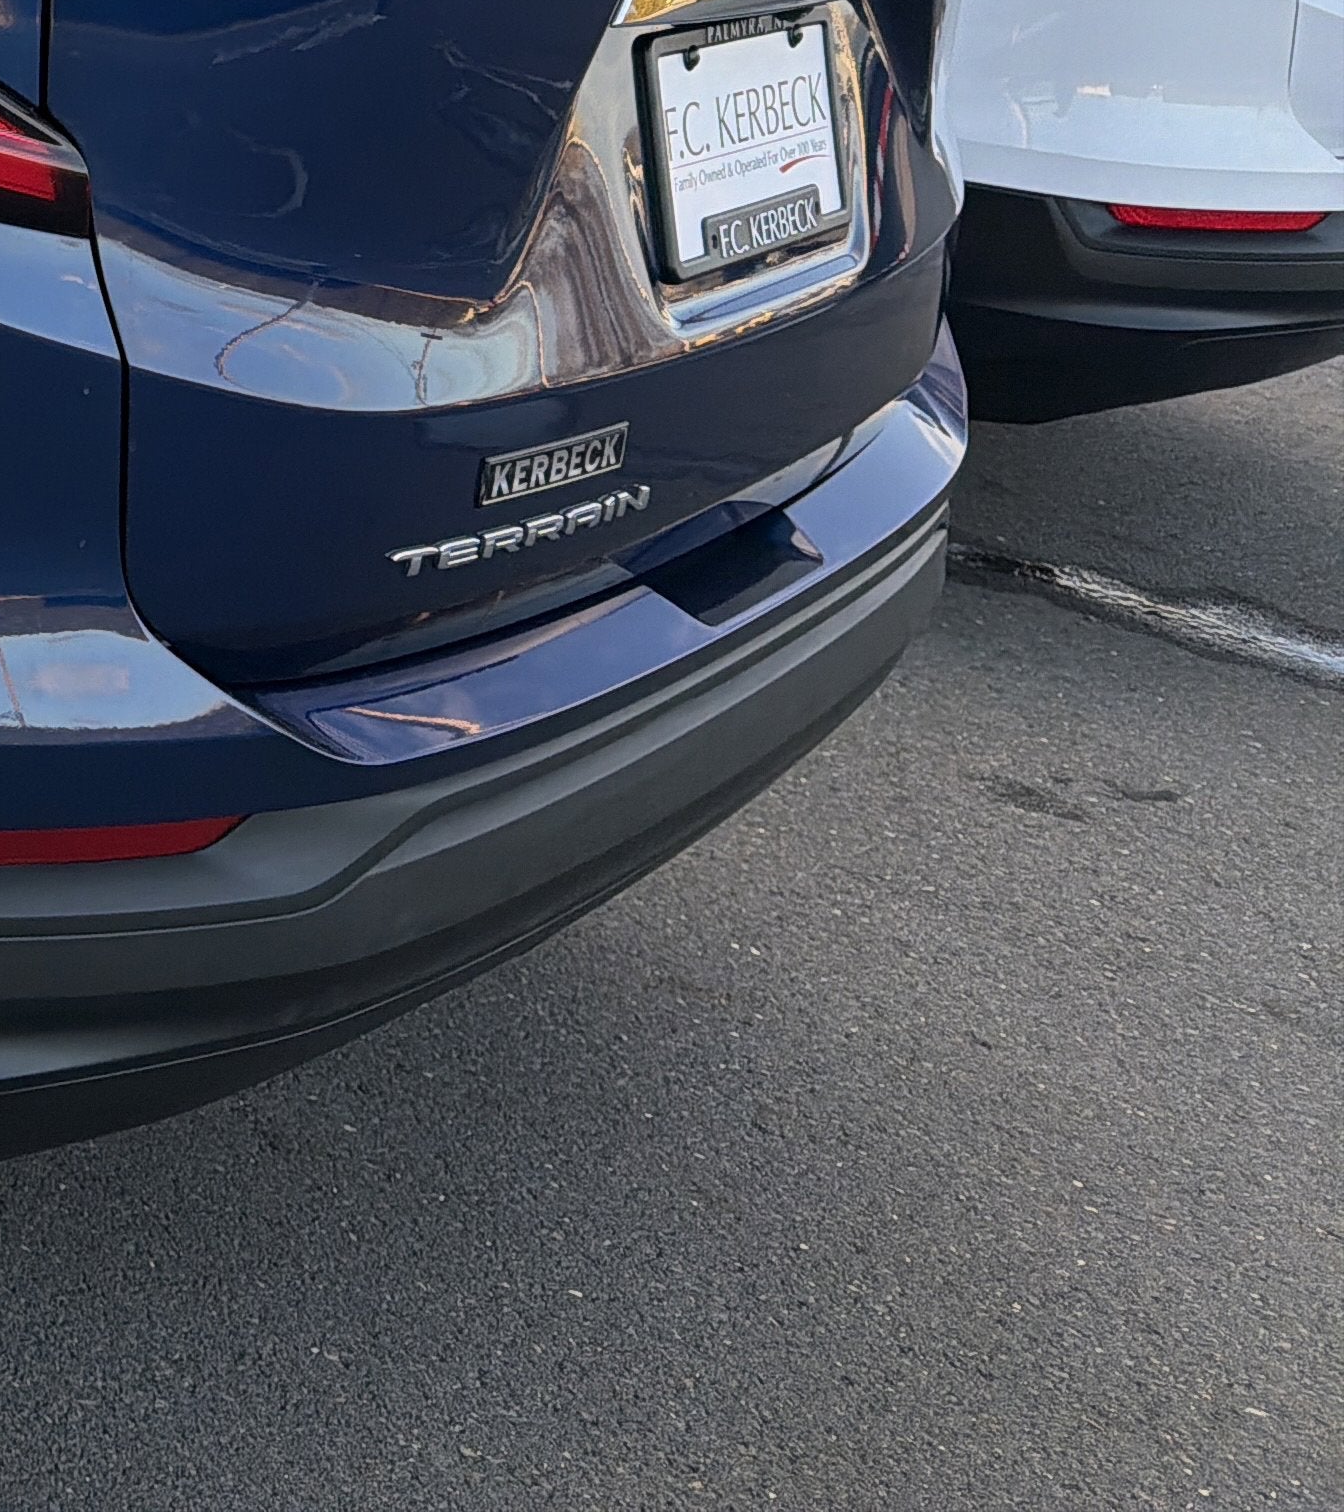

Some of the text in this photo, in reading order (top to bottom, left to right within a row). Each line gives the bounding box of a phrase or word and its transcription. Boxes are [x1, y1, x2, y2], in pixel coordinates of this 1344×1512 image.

[717, 72, 827, 150] KERBECK
[674, 172, 697, 191] Family
[699, 165, 726, 186] Owned
[727, 163, 734, 176] &
[734, 152, 767, 177] Operated
[768, 150, 779, 166] For
[780, 146, 796, 161] Over
[811, 139, 827, 154] Years
[718, 198, 818, 257] F.C. KERBECK
[489, 432, 622, 498] KERBECK
[385, 484, 651, 577] TERRAIN
